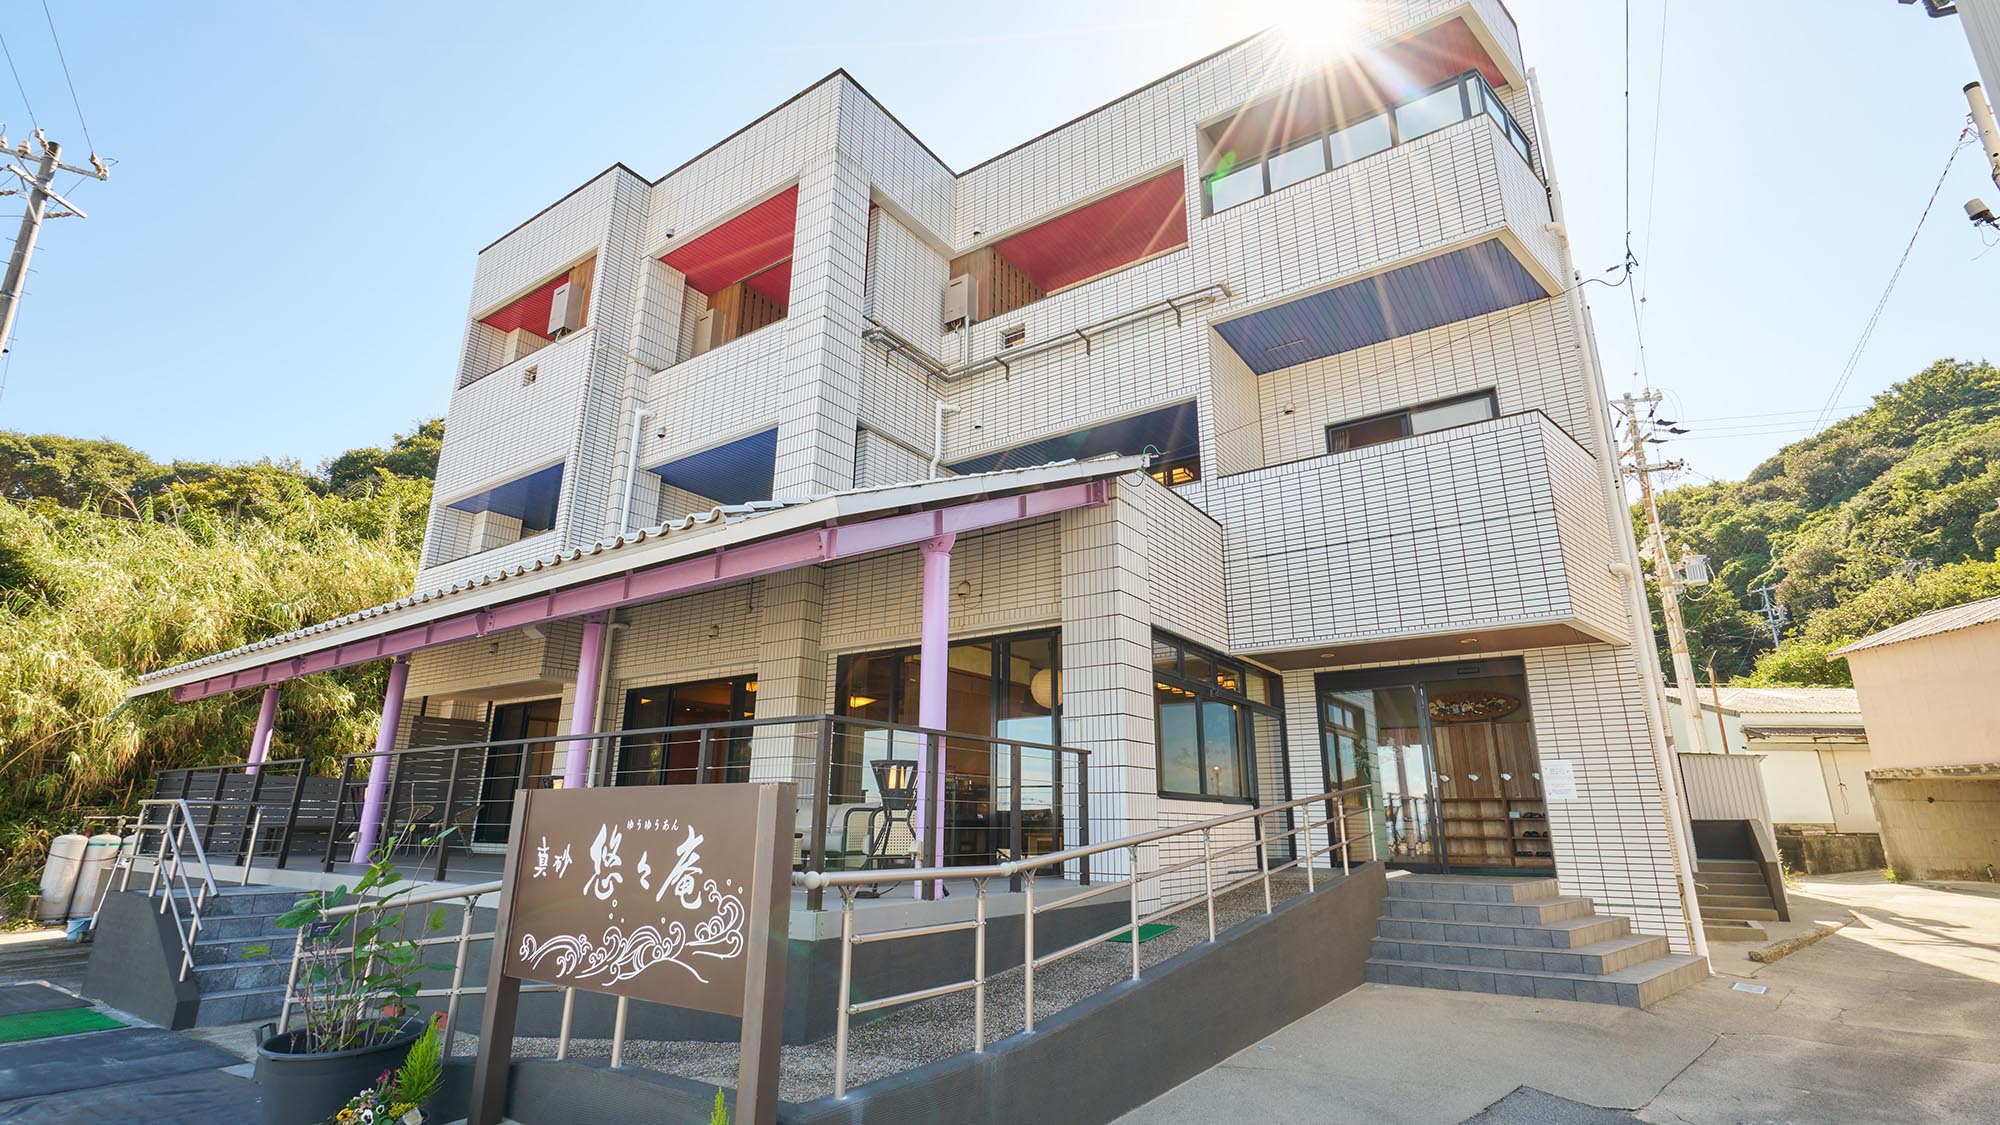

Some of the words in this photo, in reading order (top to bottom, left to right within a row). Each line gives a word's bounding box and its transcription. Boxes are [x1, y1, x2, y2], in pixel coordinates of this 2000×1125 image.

[626, 818, 679, 831] ゆうゆうあん
[533, 836, 573, 879] 真砂
[583, 823, 704, 910] 悠々庵
